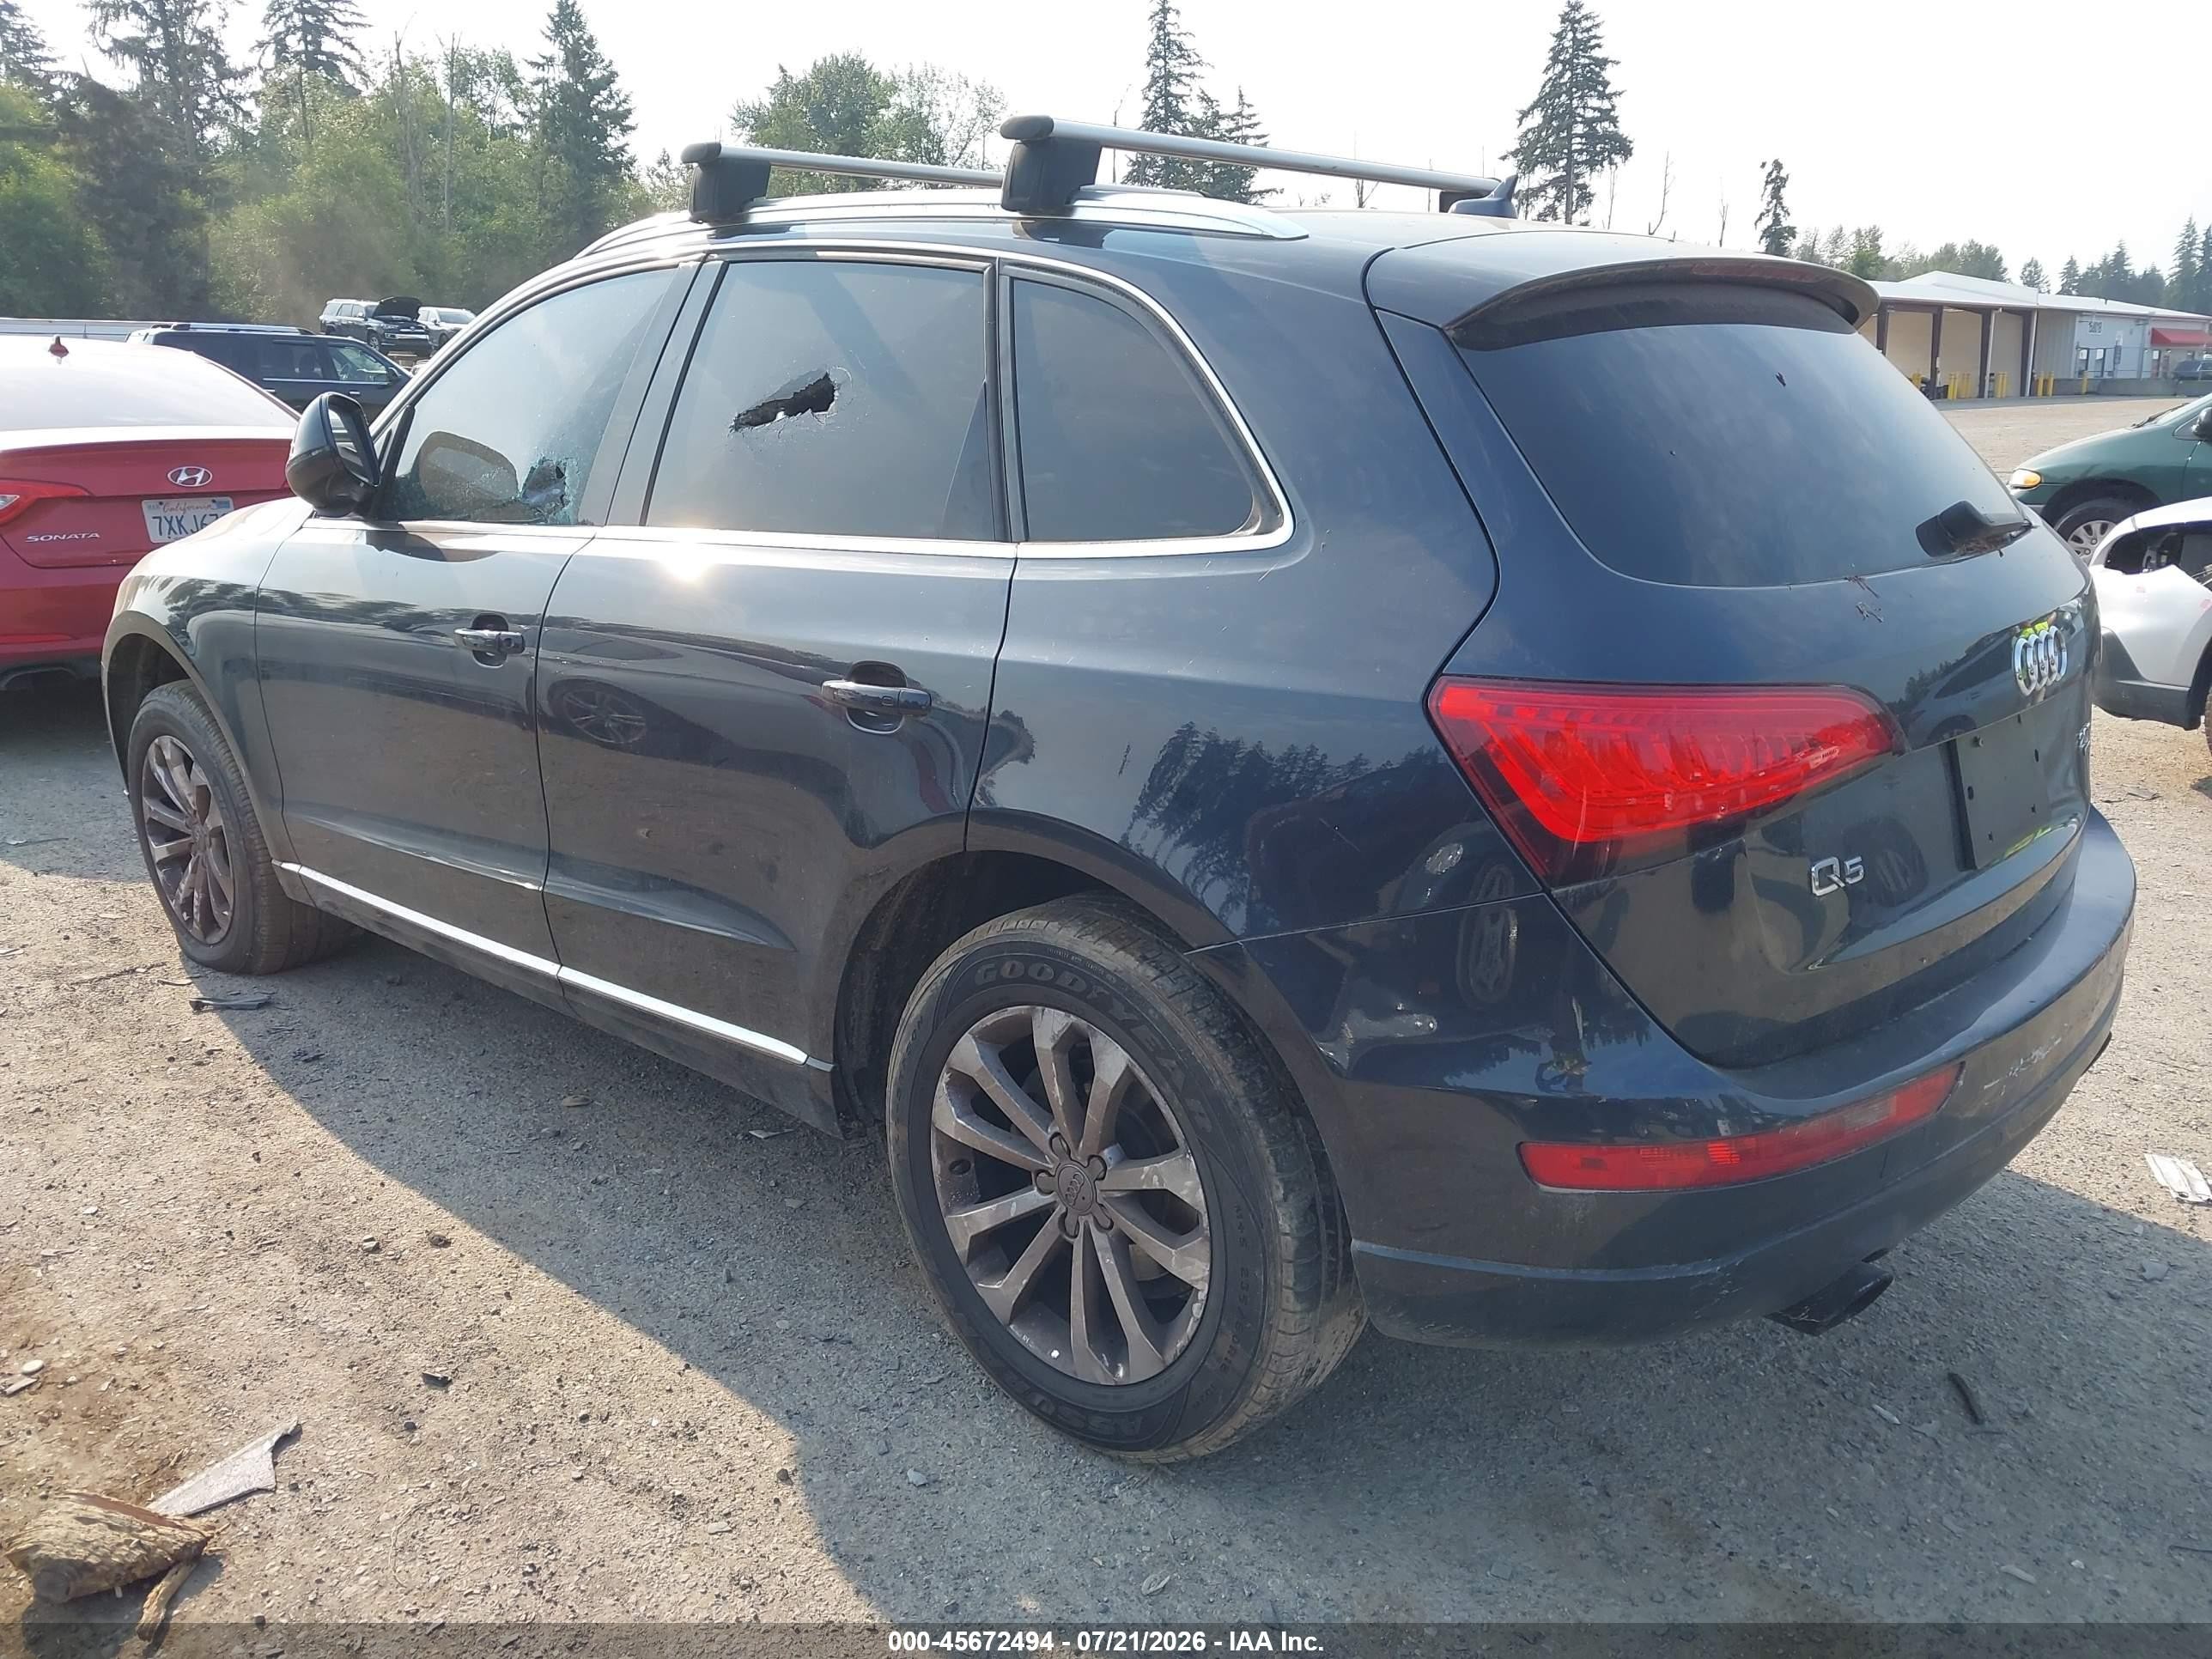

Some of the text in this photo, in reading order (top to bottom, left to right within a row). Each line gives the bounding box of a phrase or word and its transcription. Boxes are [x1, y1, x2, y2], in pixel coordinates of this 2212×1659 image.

[162, 501, 213, 514] California
[25, 532, 100, 543] SONATA
[1811, 856, 1864, 896] Q5
[974, 959, 1214, 1136] GOODYEAR
